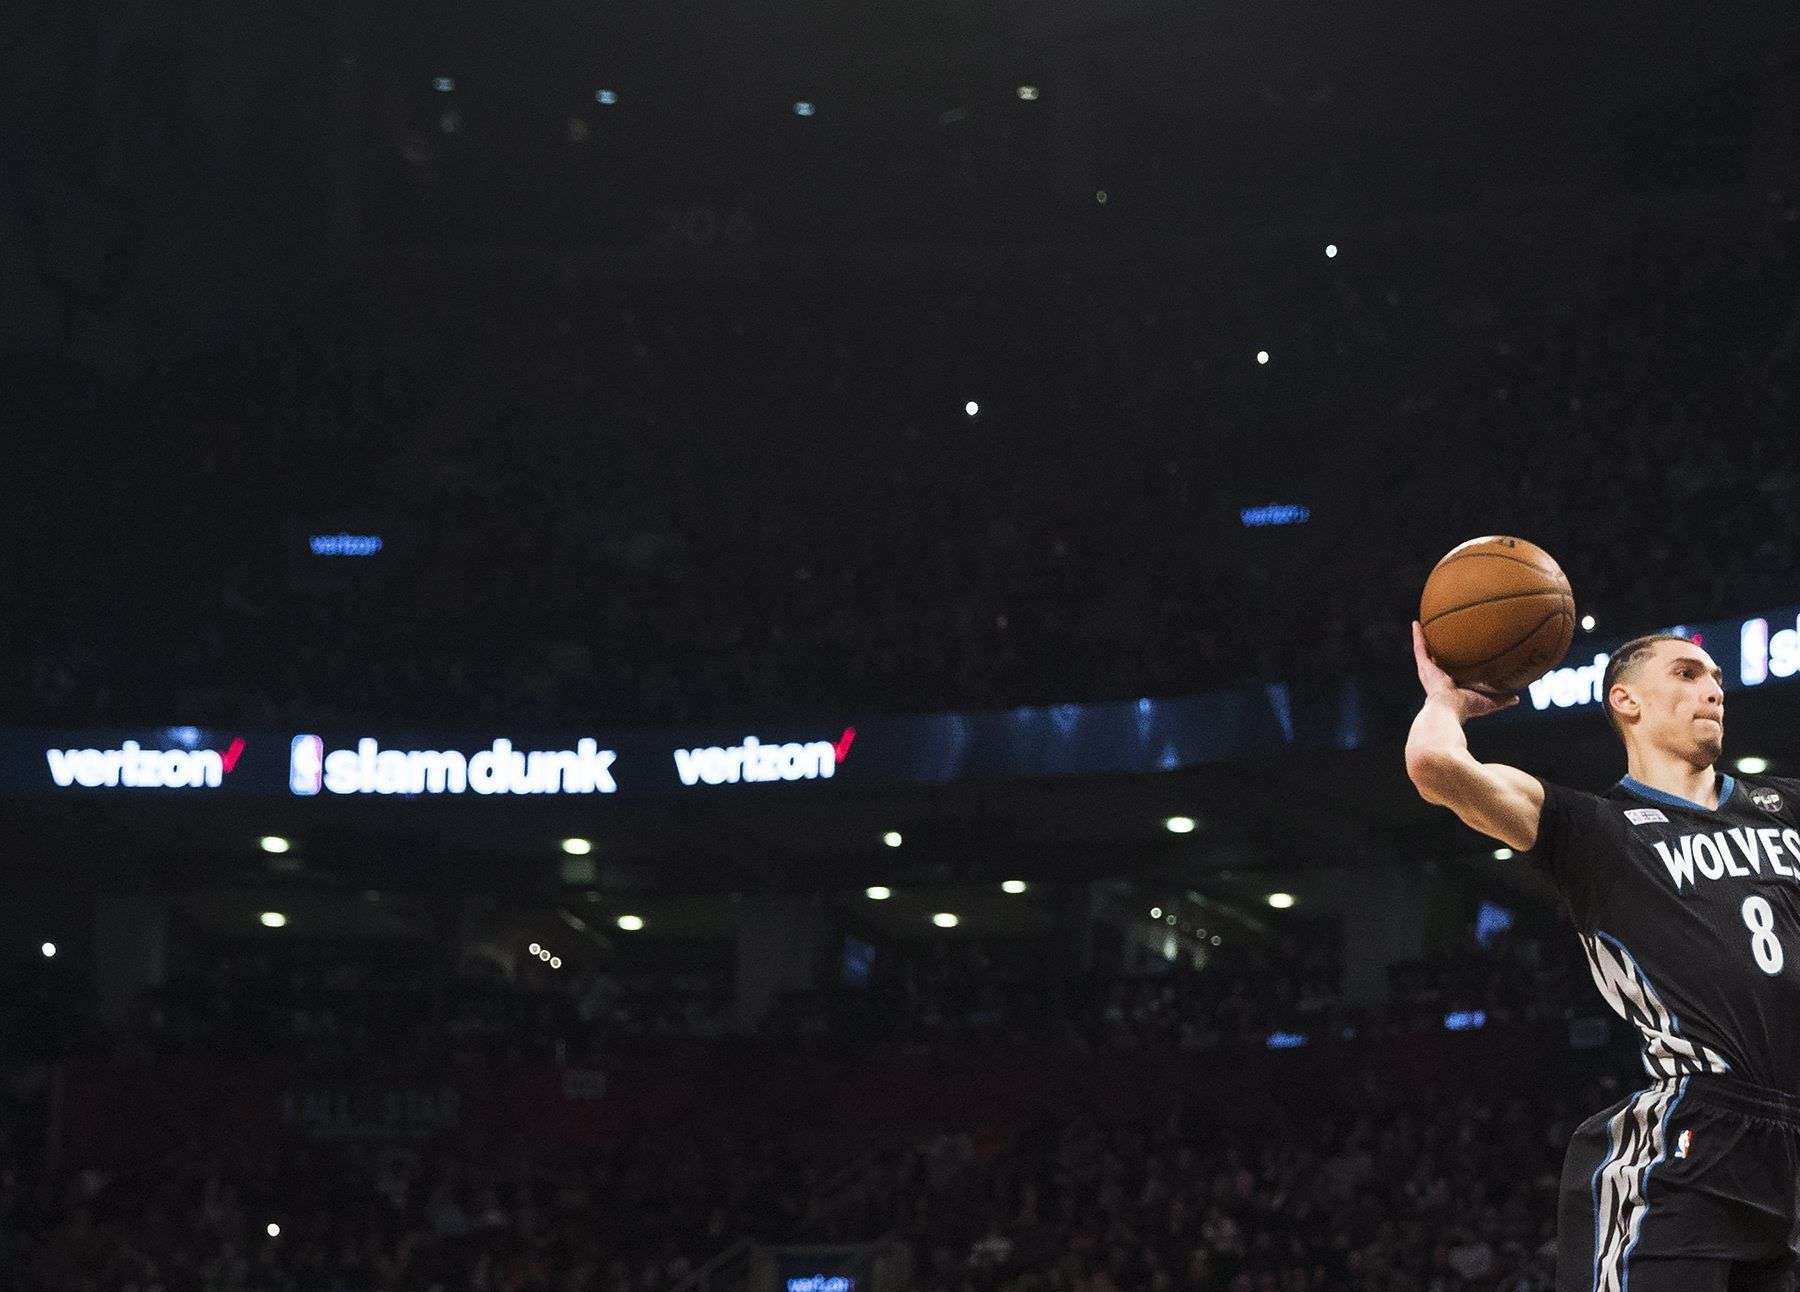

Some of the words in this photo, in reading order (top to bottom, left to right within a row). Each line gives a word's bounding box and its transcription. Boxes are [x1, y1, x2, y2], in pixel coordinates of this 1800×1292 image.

[46, 740, 223, 787] verizon
[673, 736, 836, 786] verizon
[1741, 895, 1784, 975] 8
